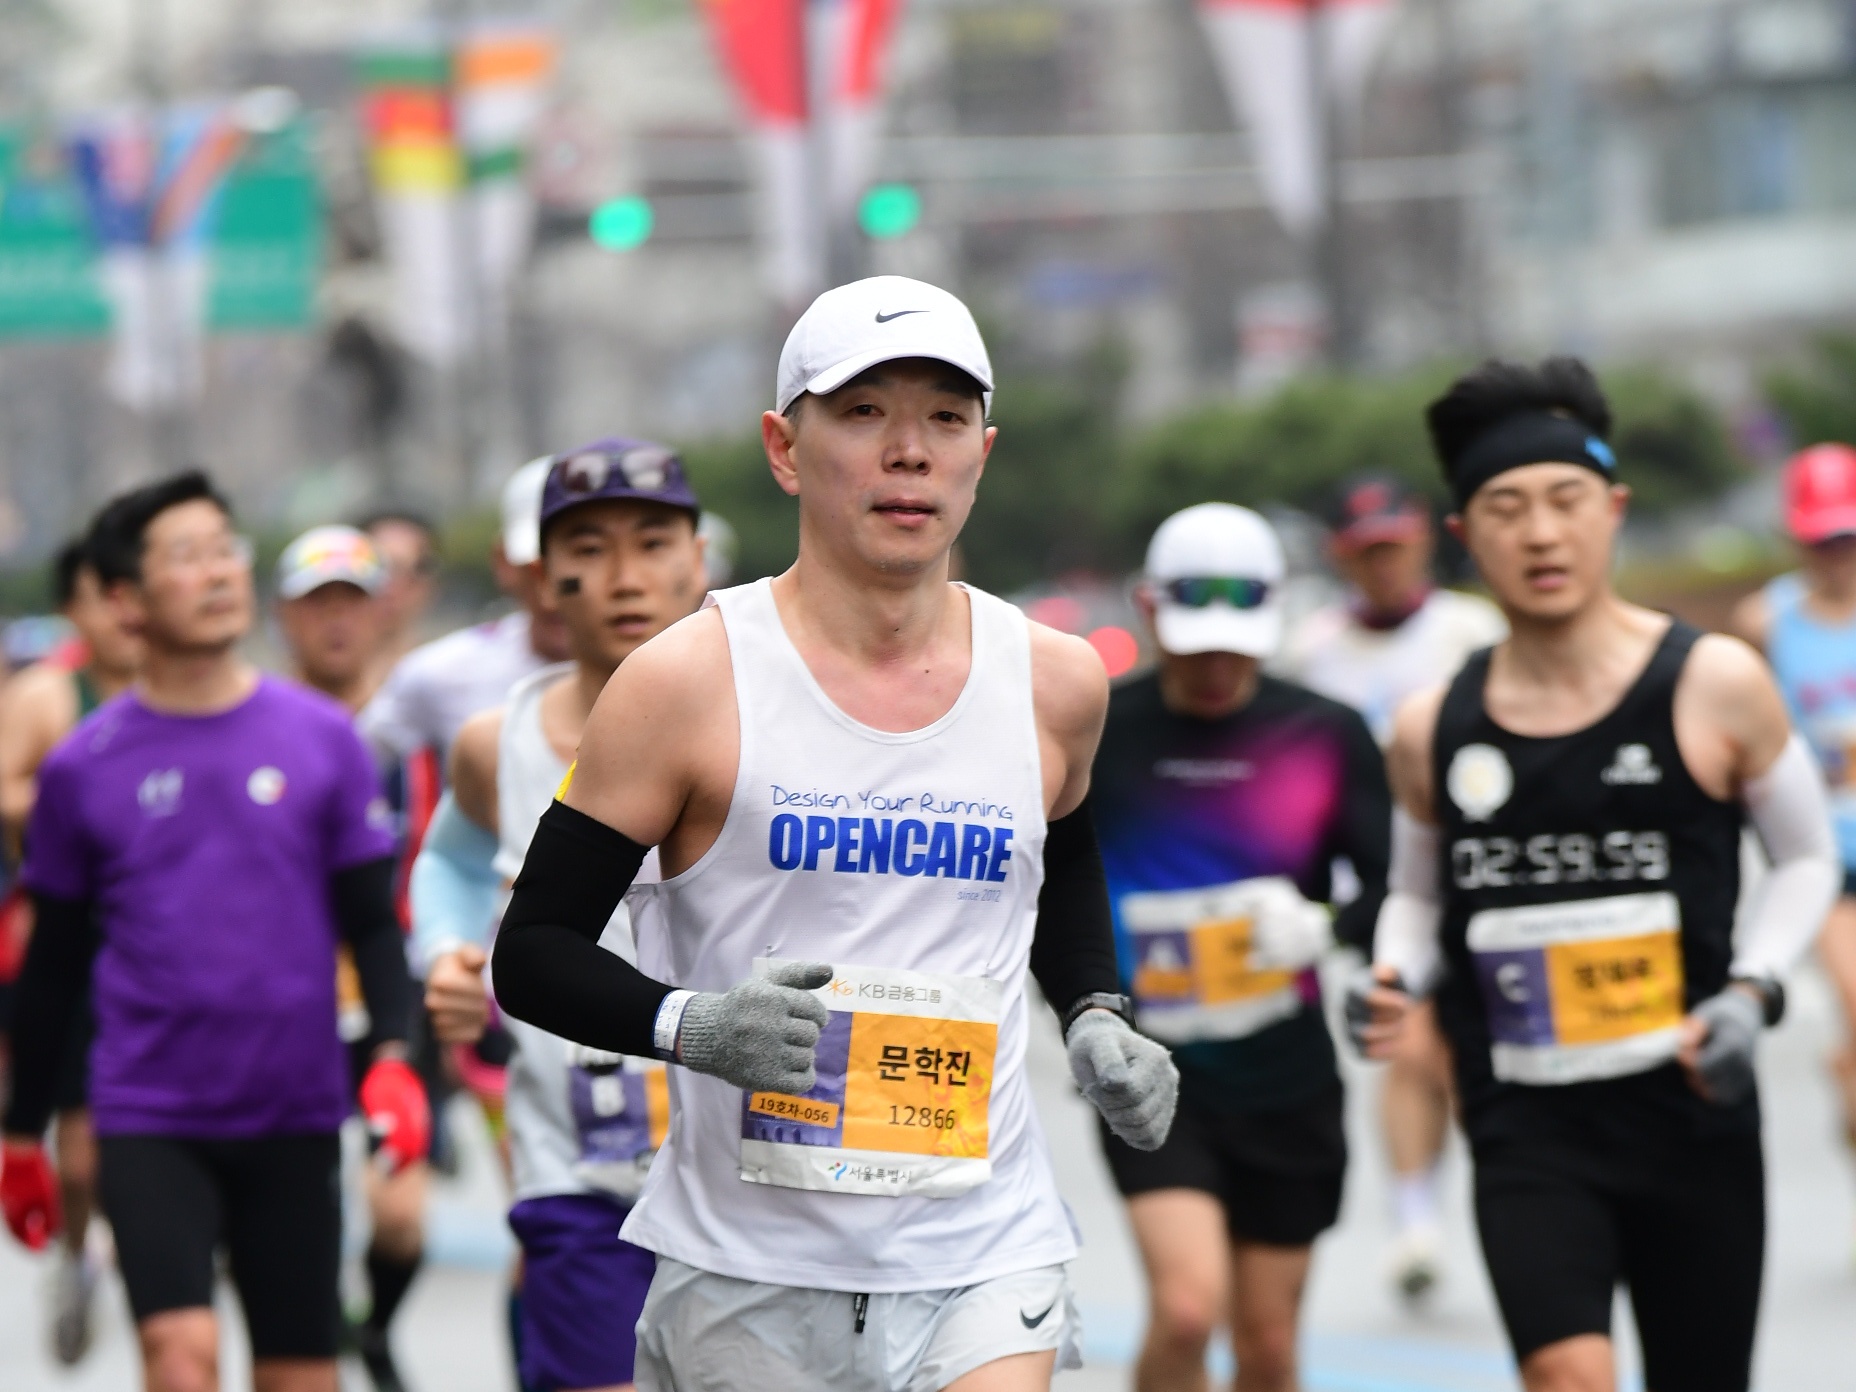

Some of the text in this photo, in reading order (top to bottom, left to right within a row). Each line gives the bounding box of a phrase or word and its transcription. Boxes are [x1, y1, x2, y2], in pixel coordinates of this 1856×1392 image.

[770, 785, 1014, 821] Design Your Running
[768, 813, 1014, 883] OPENCARE
[957, 887, 979, 901] since
[877, 1045, 971, 1087] 문학진
[758, 1097, 830, 1123] 19호차-056
[888, 1104, 956, 1130] 12866
[849, 1166, 912, 1184] 서울특별시
